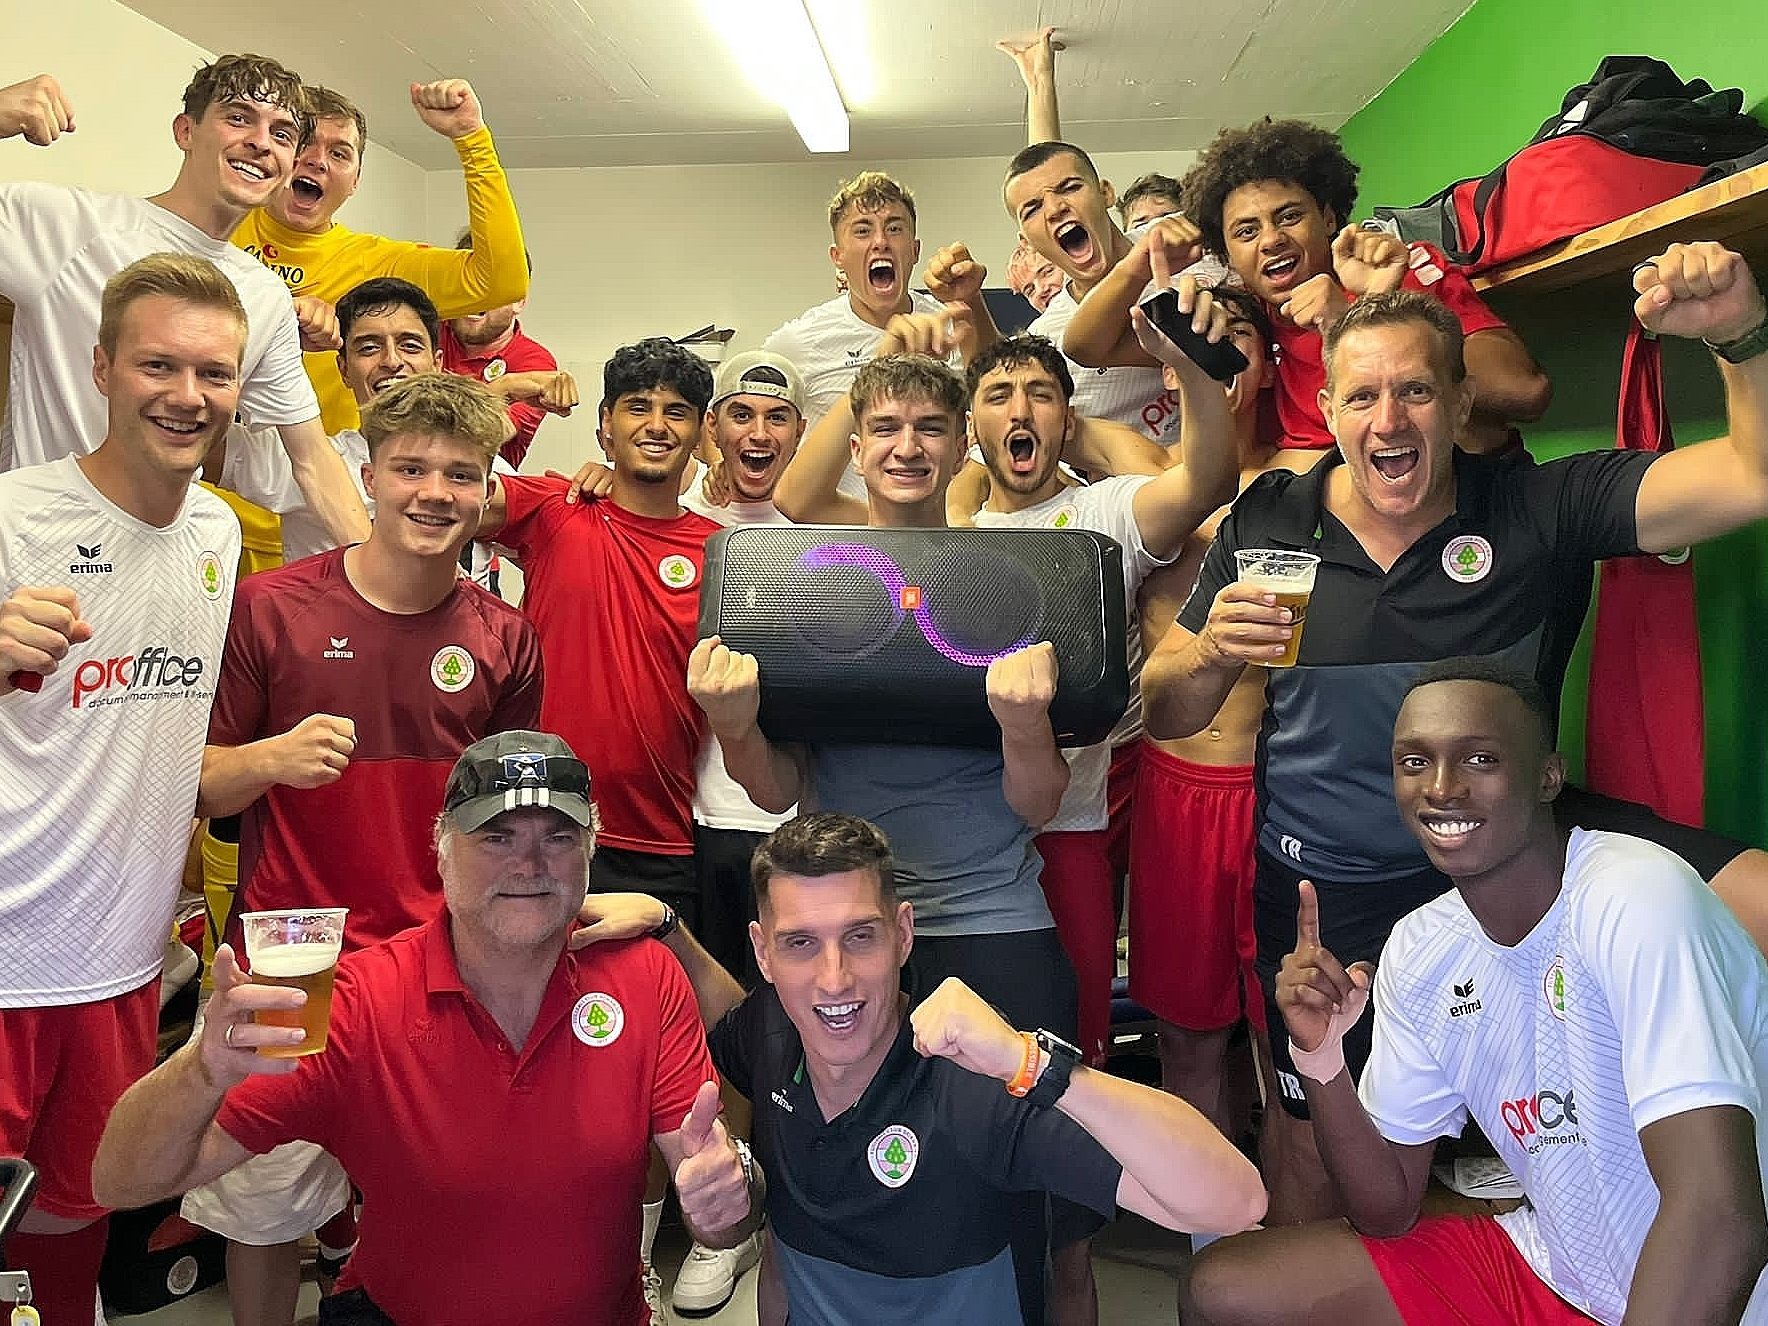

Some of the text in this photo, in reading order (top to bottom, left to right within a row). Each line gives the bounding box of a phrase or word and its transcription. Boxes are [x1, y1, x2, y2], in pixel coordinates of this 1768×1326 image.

[70, 562, 113, 574] erima
[322, 650, 354, 660] erima
[72, 646, 204, 709] proffice
[1280, 834, 1302, 863] TR
[1275, 1069, 1306, 1101] TR
